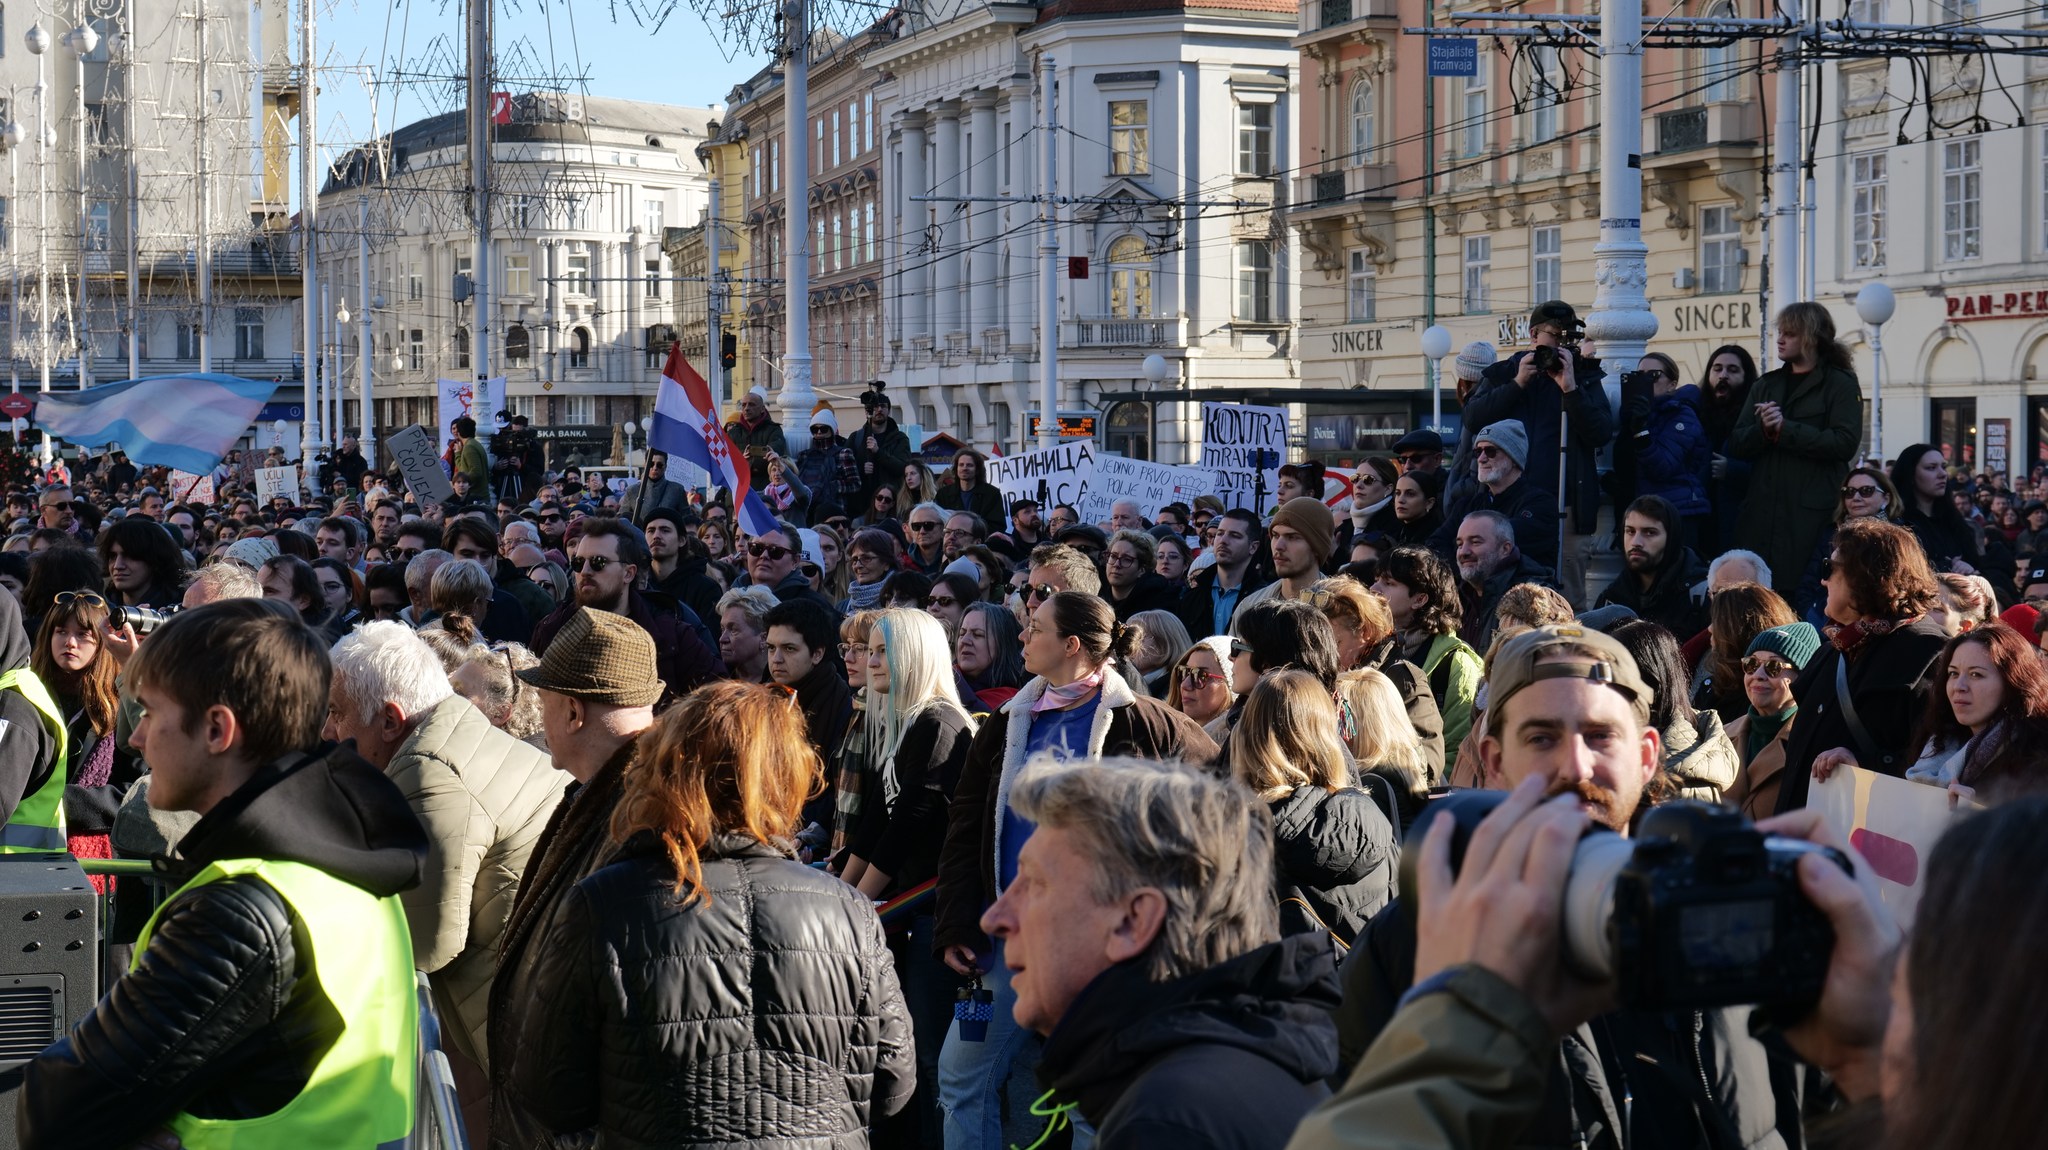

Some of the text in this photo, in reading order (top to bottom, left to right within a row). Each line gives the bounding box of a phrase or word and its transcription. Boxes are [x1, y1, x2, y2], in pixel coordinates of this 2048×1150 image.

[1433, 59, 1473, 73] tramvaja
[1947, 291, 2048, 316] PAN-PEK
[1674, 302, 1752, 332] SINGER
[1332, 329, 1383, 353] SINGER
[558, 430, 588, 438] BANKA
[1203, 406, 1288, 447] KONTRA
[1313, 426, 1336, 440] iNovine
[408, 430, 436, 468] PRVO
[263, 469, 285, 481] UČILI
[397, 448, 435, 504] ČOVJEK
[1097, 458, 1172, 486] JEDINO PRVO
[267, 480, 284, 492] STE
[1105, 477, 1164, 501] POLJE NA
